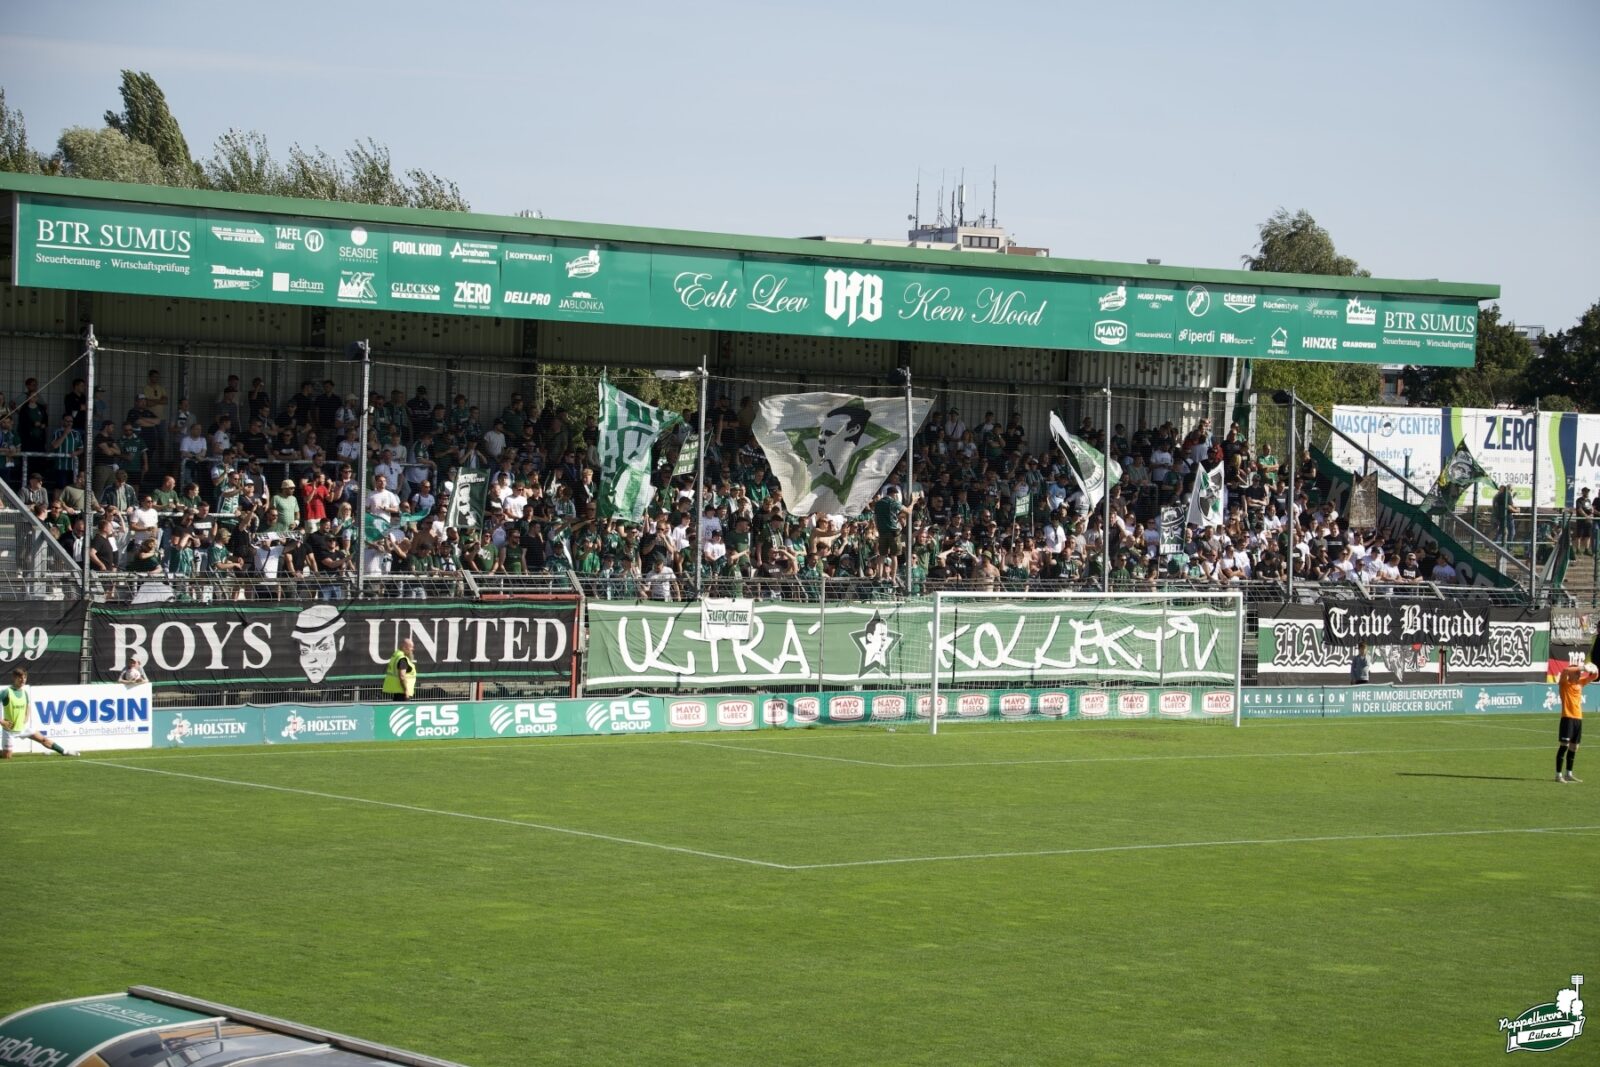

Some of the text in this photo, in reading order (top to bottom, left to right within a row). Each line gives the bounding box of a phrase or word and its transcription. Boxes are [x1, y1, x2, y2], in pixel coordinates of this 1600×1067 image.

[36, 219, 91, 245] BTR
[100, 225, 191, 253] SUMUS
[275, 227, 302, 241] TAFEL
[275, 241, 295, 251] LÜBECK
[339, 246, 378, 260] SEASIDE
[36, 253, 190, 275] Steuerberatung Wirtschaftsprüfung
[504, 291, 551, 306] DELLPRO
[674, 272, 809, 313] Echt Leev
[1224, 293, 1256, 303] clement
[558, 299, 604, 311] JABLONKA
[899, 282, 1047, 326] Keen Mood
[1385, 312, 1415, 330] BTR
[1420, 314, 1475, 333] SUMUS
[1097, 326, 1124, 337] MAYO
[1188, 330, 1215, 344] iperdi
[1303, 336, 1337, 350] HINZKE
[1382, 337, 1473, 350] Steuerberatung Wirtschaftsprüfung
[1335, 415, 1440, 434] WASCH CENTER
[1328, 604, 1484, 643] Trave Brigade
[109, 616, 567, 672] BOYS UNITED
[1005, 697, 1026, 705] MAYO
[1044, 696, 1064, 704] MAYO
[1244, 693, 1345, 704] KENSINGTON
[1352, 689, 1463, 701] IHRE IMMOBILIENEXPERTEN
[1491, 695, 1523, 705] HOLSTEN
[723, 704, 748, 712] MAYO
[835, 699, 859, 707] MAYO
[877, 699, 901, 707] MAYO
[963, 698, 984, 706] MAYO
[1352, 700, 1454, 713] IN DER LÜBECKER BUCHT.
[35, 698, 149, 725] WOISIN
[416, 705, 460, 726] FLS
[515, 703, 557, 724] FLS
[609, 701, 651, 720] FLS
[676, 705, 701, 713] MAYO
[194, 722, 246, 735] HOLSTEN
[307, 719, 357, 732] HOLSTEN
[415, 726, 459, 737] GROUP
[515, 724, 557, 734] GROUP
[611, 720, 651, 731] GROUP
